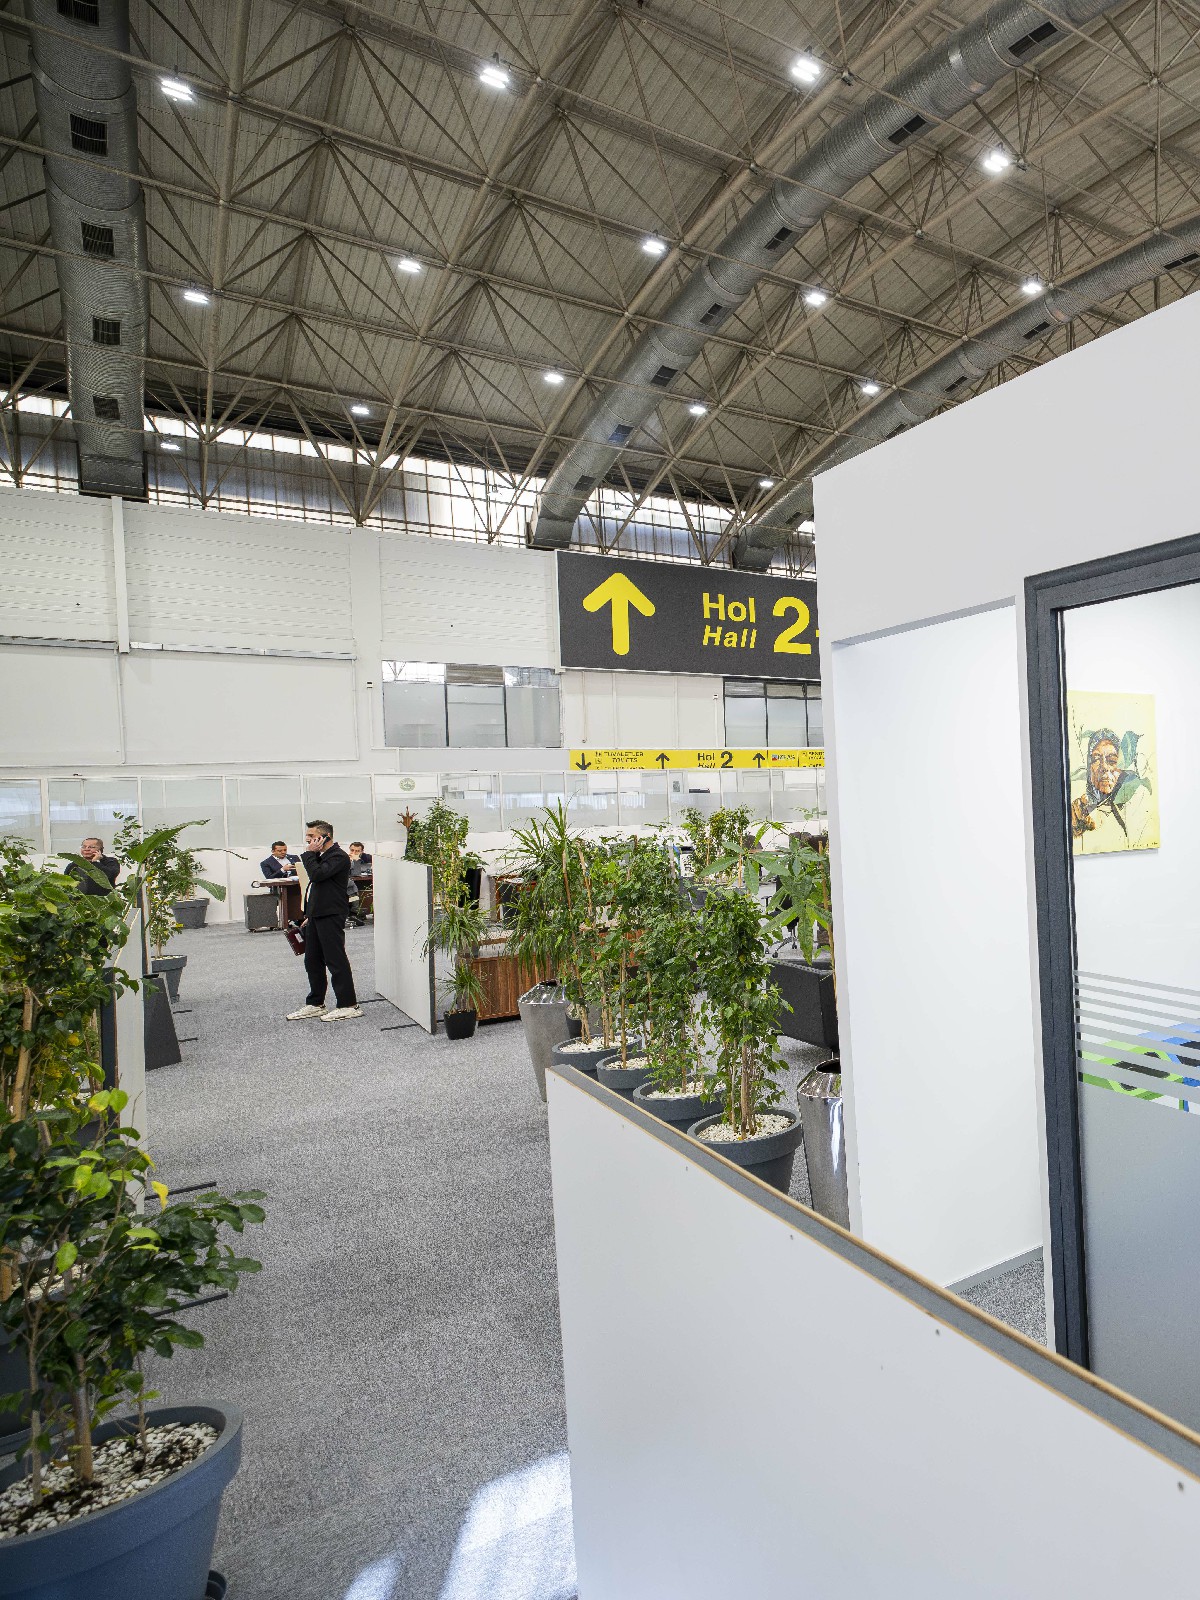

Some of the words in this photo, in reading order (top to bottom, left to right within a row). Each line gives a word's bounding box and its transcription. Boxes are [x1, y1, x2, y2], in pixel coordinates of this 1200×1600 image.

[702, 592, 756, 624] Hol
[702, 625, 757, 649] Hall
[697, 752, 715, 761] Hol
[720, 751, 734, 768] 2
